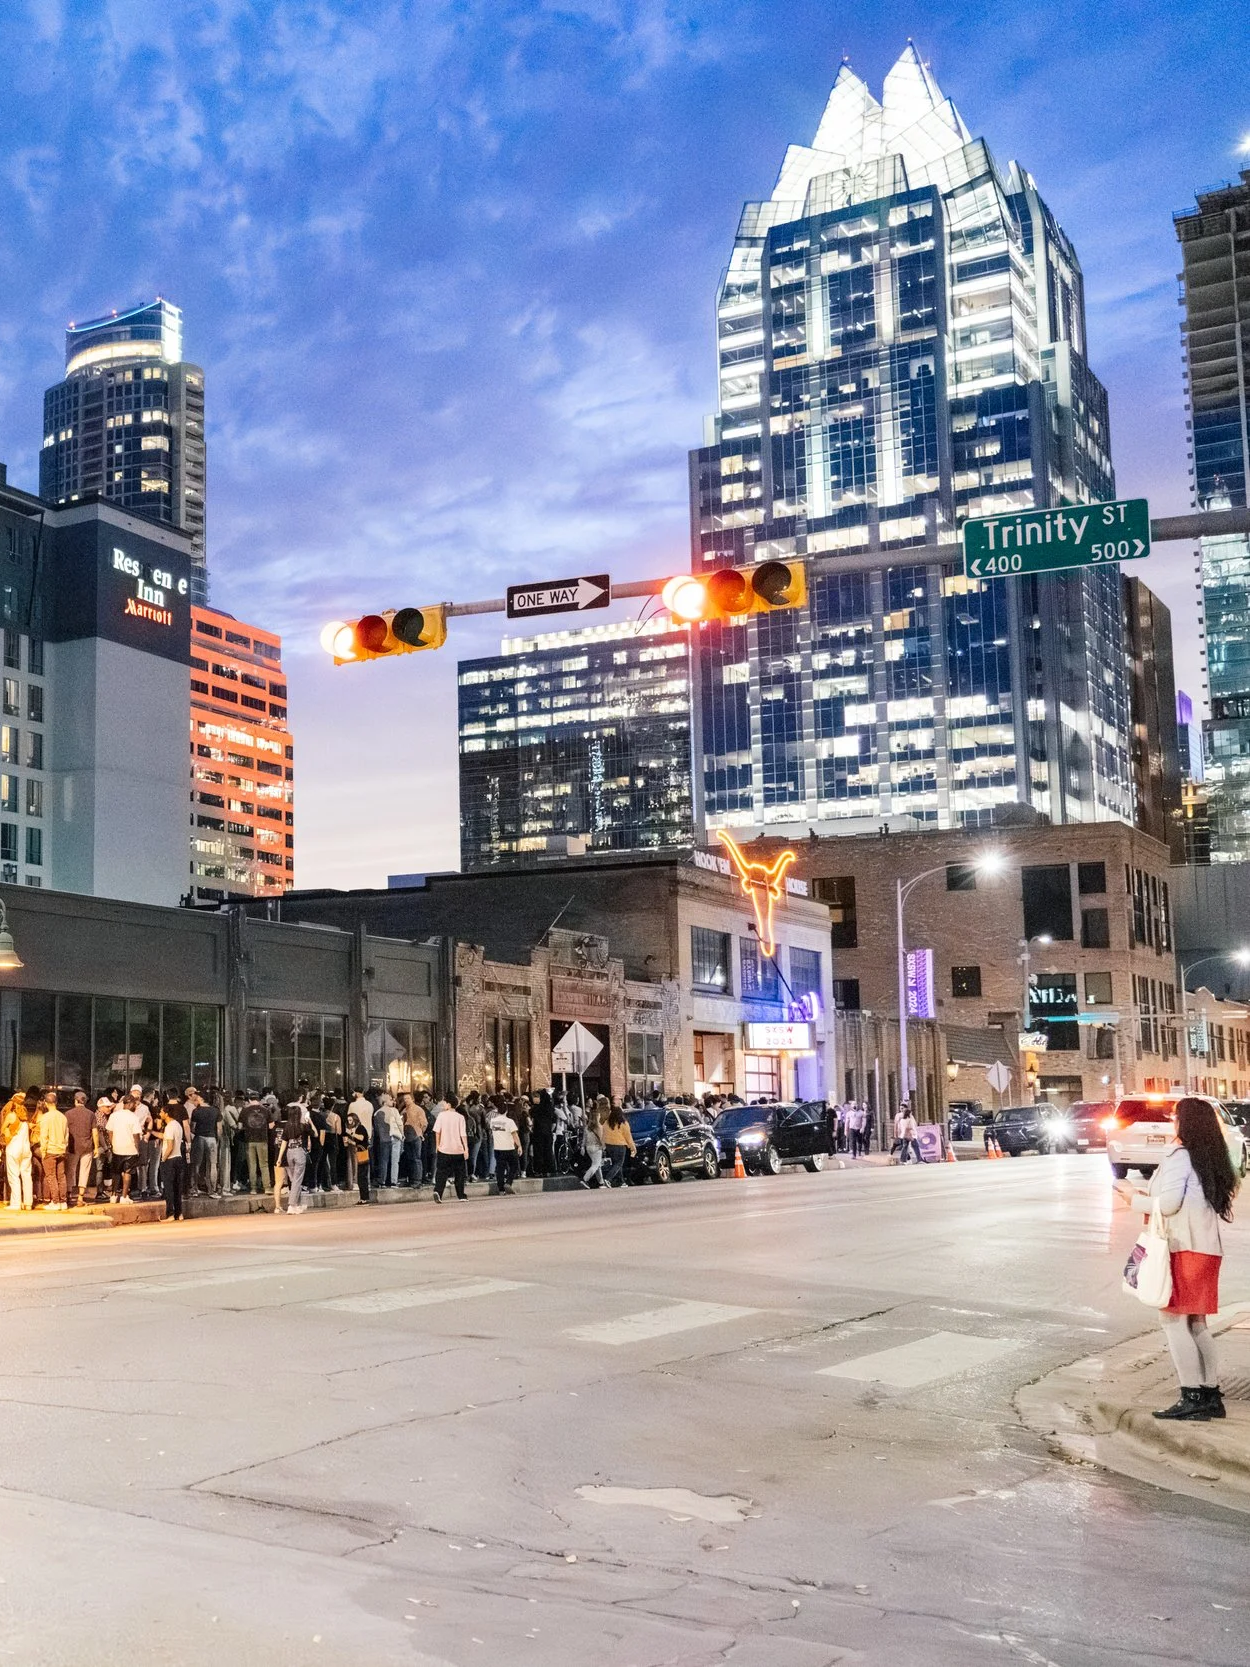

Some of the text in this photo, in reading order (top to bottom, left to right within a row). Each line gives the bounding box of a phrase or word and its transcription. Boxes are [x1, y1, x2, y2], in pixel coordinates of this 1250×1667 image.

[983, 504, 1128, 550] Trinity ST
[1091, 540, 1129, 562] 500
[113, 548, 188, 595] Resene
[985, 554, 1022, 574] 400
[136, 578, 165, 607] Inn
[517, 588, 579, 608] ONE WAY
[124, 598, 172, 627] Marriott
[694, 850, 718, 873] HOOK
[907, 953, 918, 1014] SXSW 2024
[765, 1026, 793, 1034] SXSW
[765, 1037, 793, 1046] 2024
